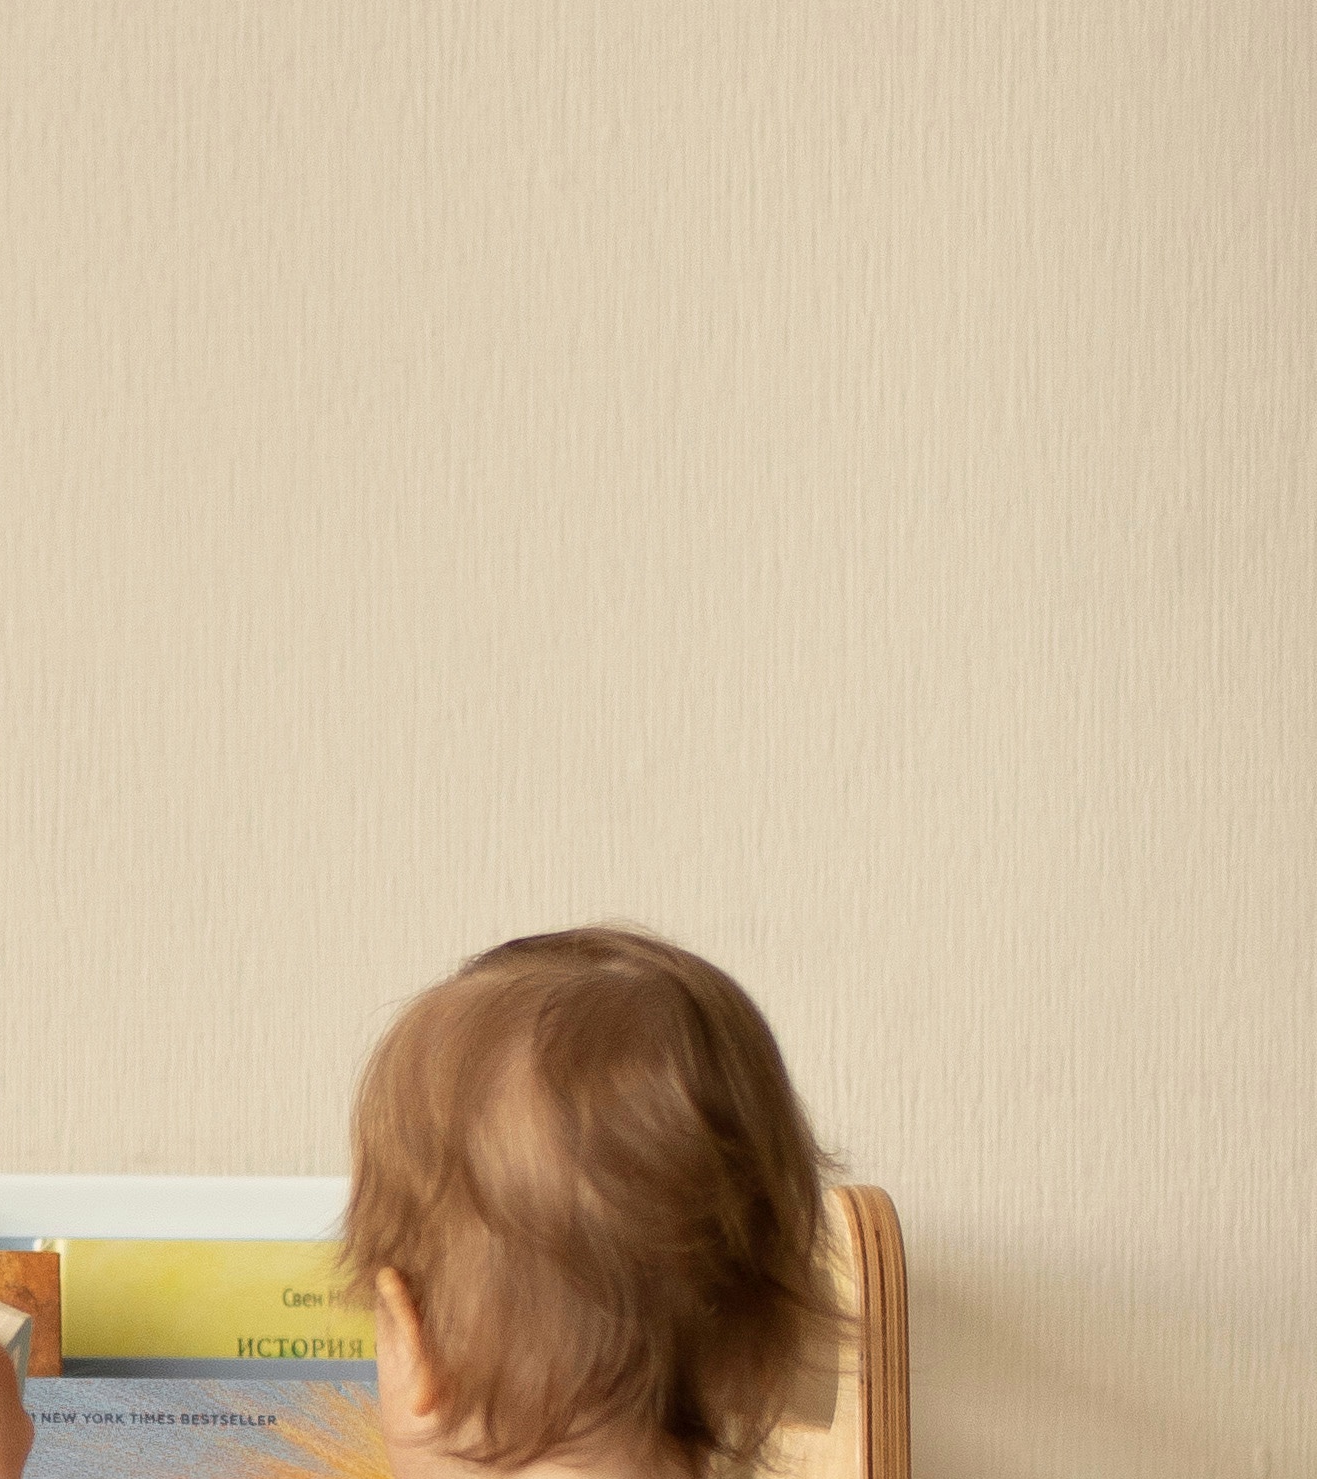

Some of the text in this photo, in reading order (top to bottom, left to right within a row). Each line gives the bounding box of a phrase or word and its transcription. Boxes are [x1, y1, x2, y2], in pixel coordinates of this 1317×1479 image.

[283, 1288, 323, 1308] Свен
[237, 1337, 363, 1358] ИСТОРИЯ
[41, 1412, 76, 1424] NEW
[82, 1413, 126, 1425] YORK
[129, 1413, 175, 1425] TIMES
[180, 1413, 278, 1427] BESTSELLER
